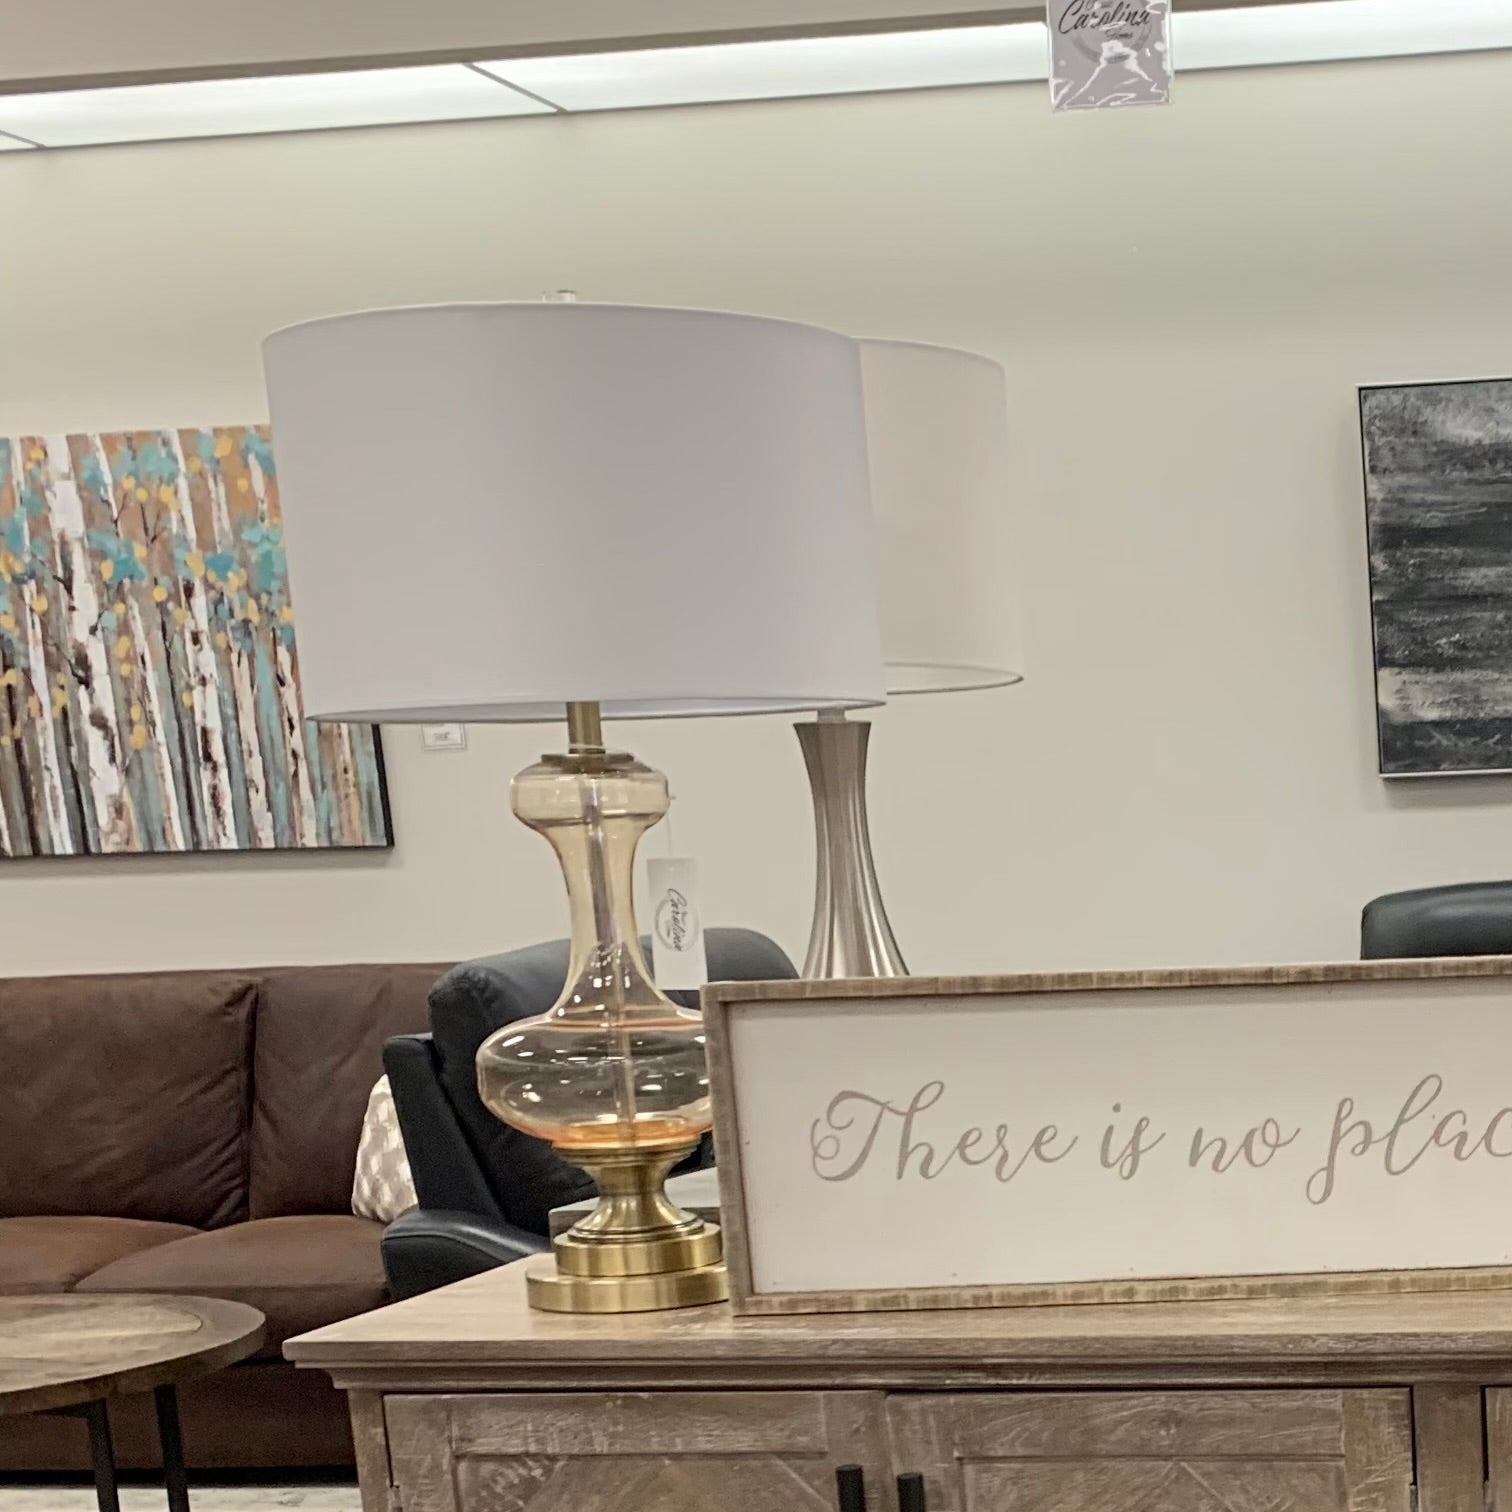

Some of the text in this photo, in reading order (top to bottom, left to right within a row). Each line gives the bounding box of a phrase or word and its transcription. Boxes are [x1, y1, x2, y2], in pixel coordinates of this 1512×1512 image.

[1058, 0, 1151, 34] Carolina
[666, 888, 688, 951] Carolina
[810, 1080, 1077, 1182] There
[1100, 1103, 1166, 1181] is
[1188, 1116, 1301, 1173] no
